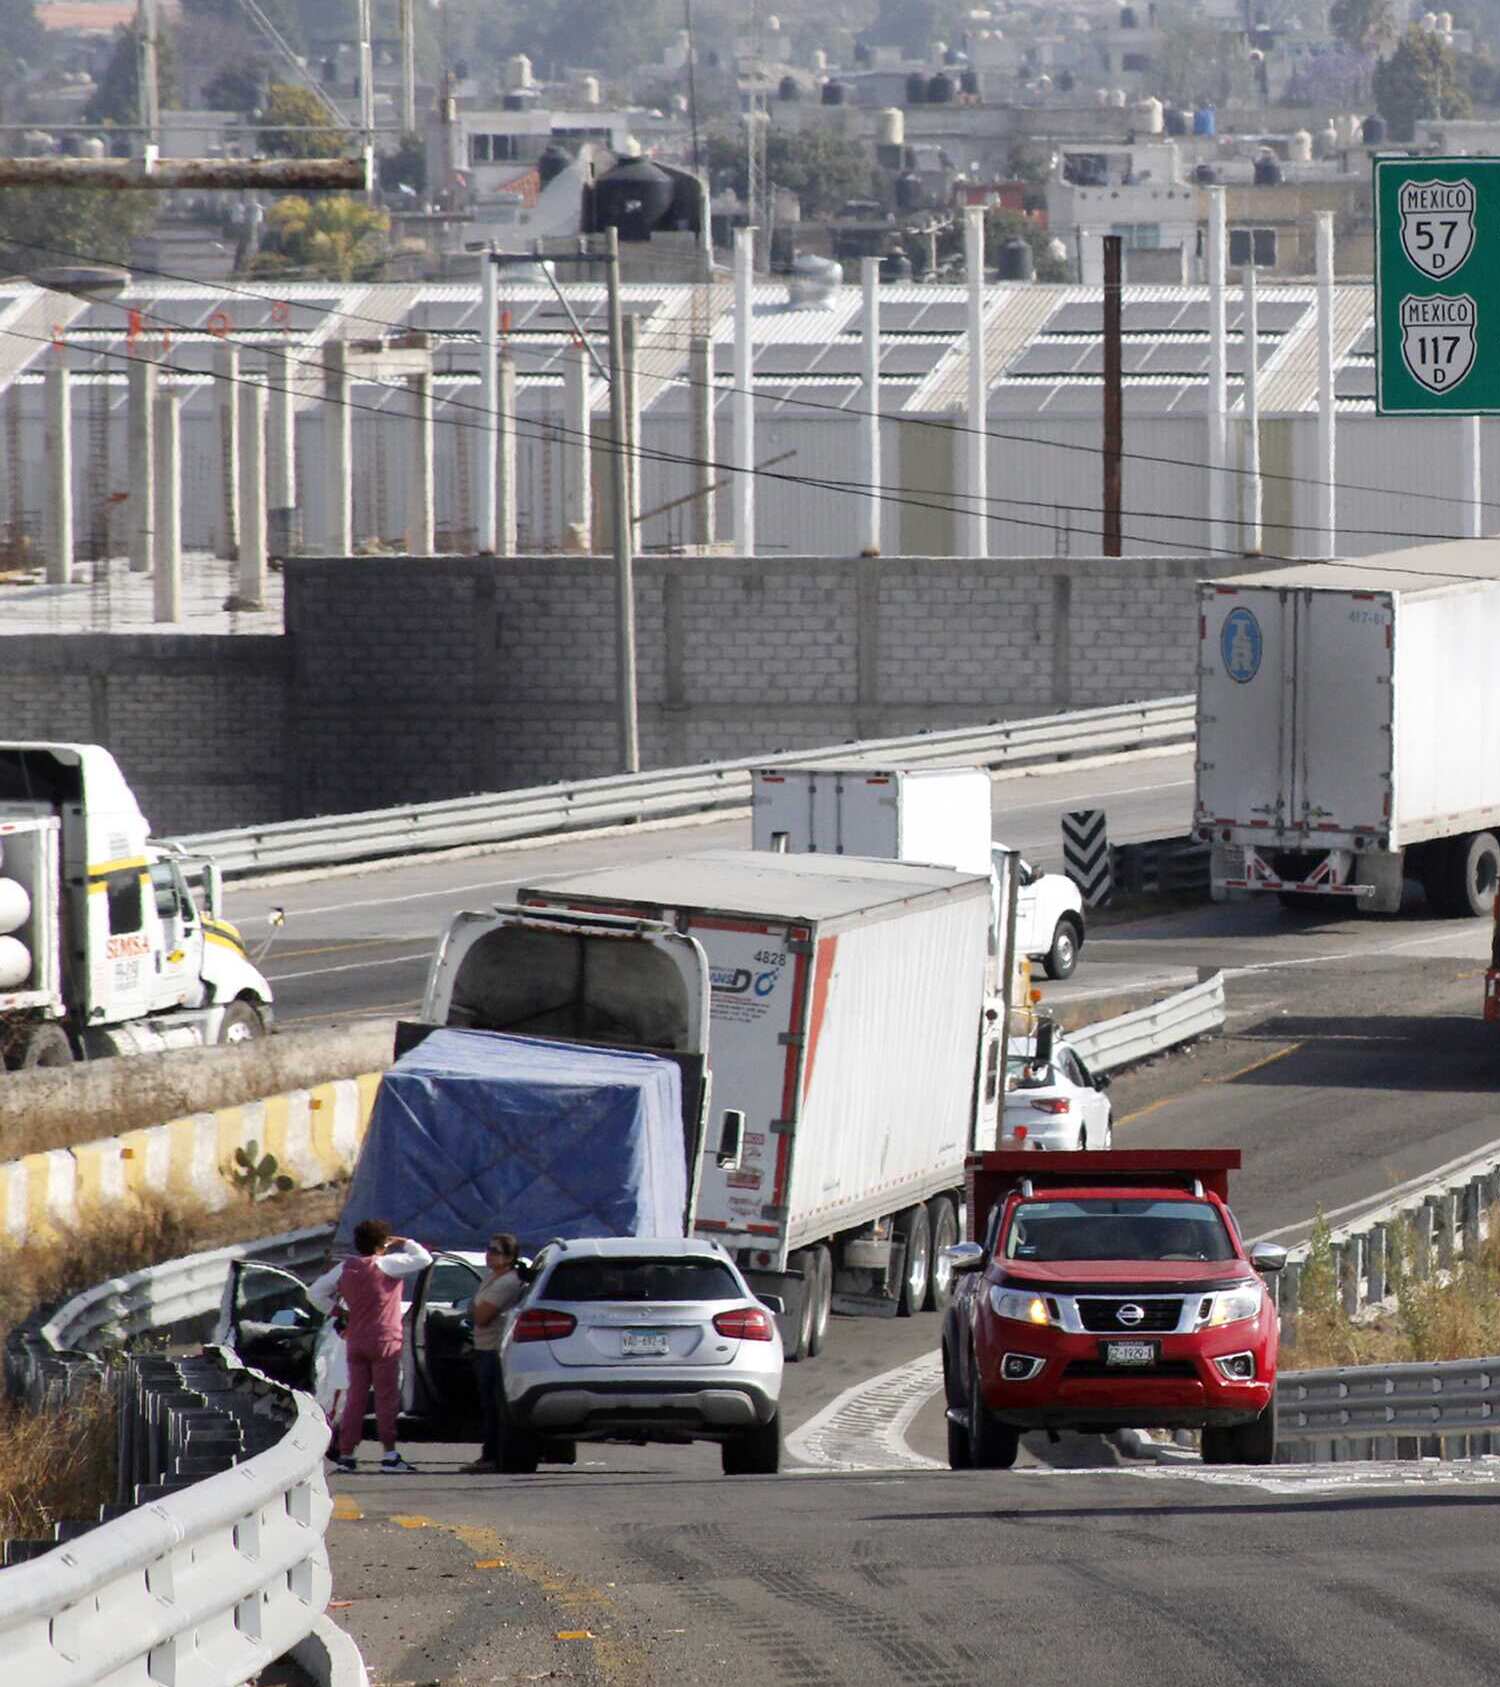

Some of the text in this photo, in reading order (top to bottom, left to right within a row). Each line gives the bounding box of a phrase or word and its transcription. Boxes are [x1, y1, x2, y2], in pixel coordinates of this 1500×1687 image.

[1408, 188, 1467, 209] MEXICO
[1415, 221, 1459, 251] 57
[1432, 252, 1446, 270] D
[1408, 303, 1468, 323] MEXICO
[1417, 335, 1460, 365] 117
[1432, 367, 1446, 385] D
[753, 948, 786, 967] 4828
